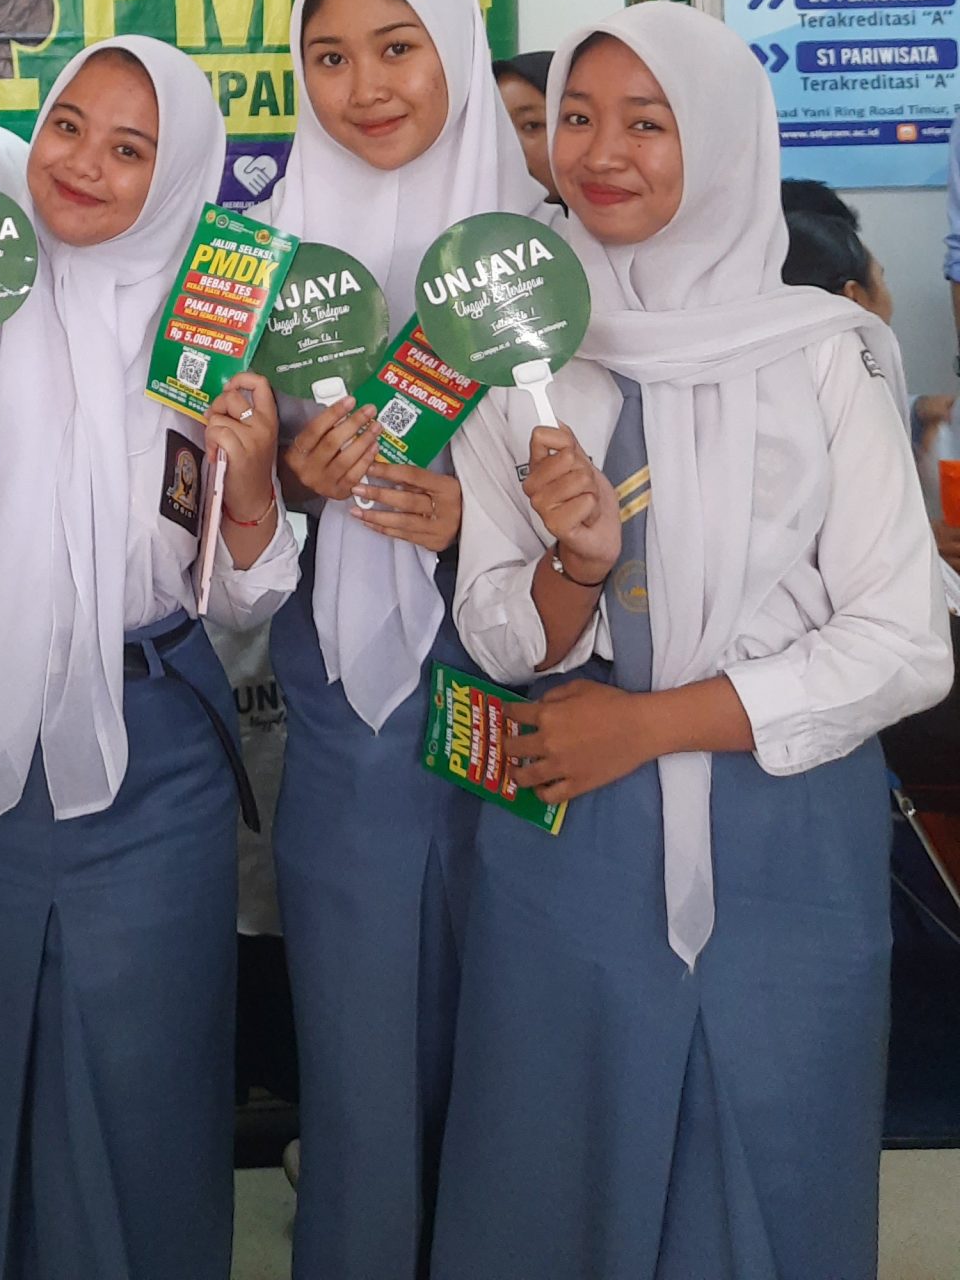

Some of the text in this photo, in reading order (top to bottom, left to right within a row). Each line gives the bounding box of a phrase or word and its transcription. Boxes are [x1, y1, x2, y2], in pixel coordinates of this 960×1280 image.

[798, 10, 917, 28] Terakreditasi
[816, 45, 939, 65] S1 PARIWISATA
[800, 74, 920, 91] Terakreditasi
[803, 107, 830, 118] Yani
[835, 106, 865, 120] Ring
[869, 105, 904, 116] Road
[210, 238, 237, 251] JALUR
[238, 244, 275, 259] SELEKSI
[190, 244, 279, 289] PMDK
[423, 238, 555, 305] UNJAYA
[200, 276, 253, 296] BEBAS TES
[452, 291, 491, 319] Unggul
[502, 276, 544, 298] Terdepan
[184, 298, 249, 322] PAKAI RAPOR
[268, 303, 350, 336] Unggul & Terdepan
[170, 326, 184, 340] Rp
[184, 331, 239, 354] 5.000.000,-
[407, 347, 472, 388] PAKAI RAPOR
[383, 371, 454, 415] Rp 5.000.000,-
[449, 680, 472, 779] PMDK
[486, 705, 499, 781] PAKAI RAPOR
